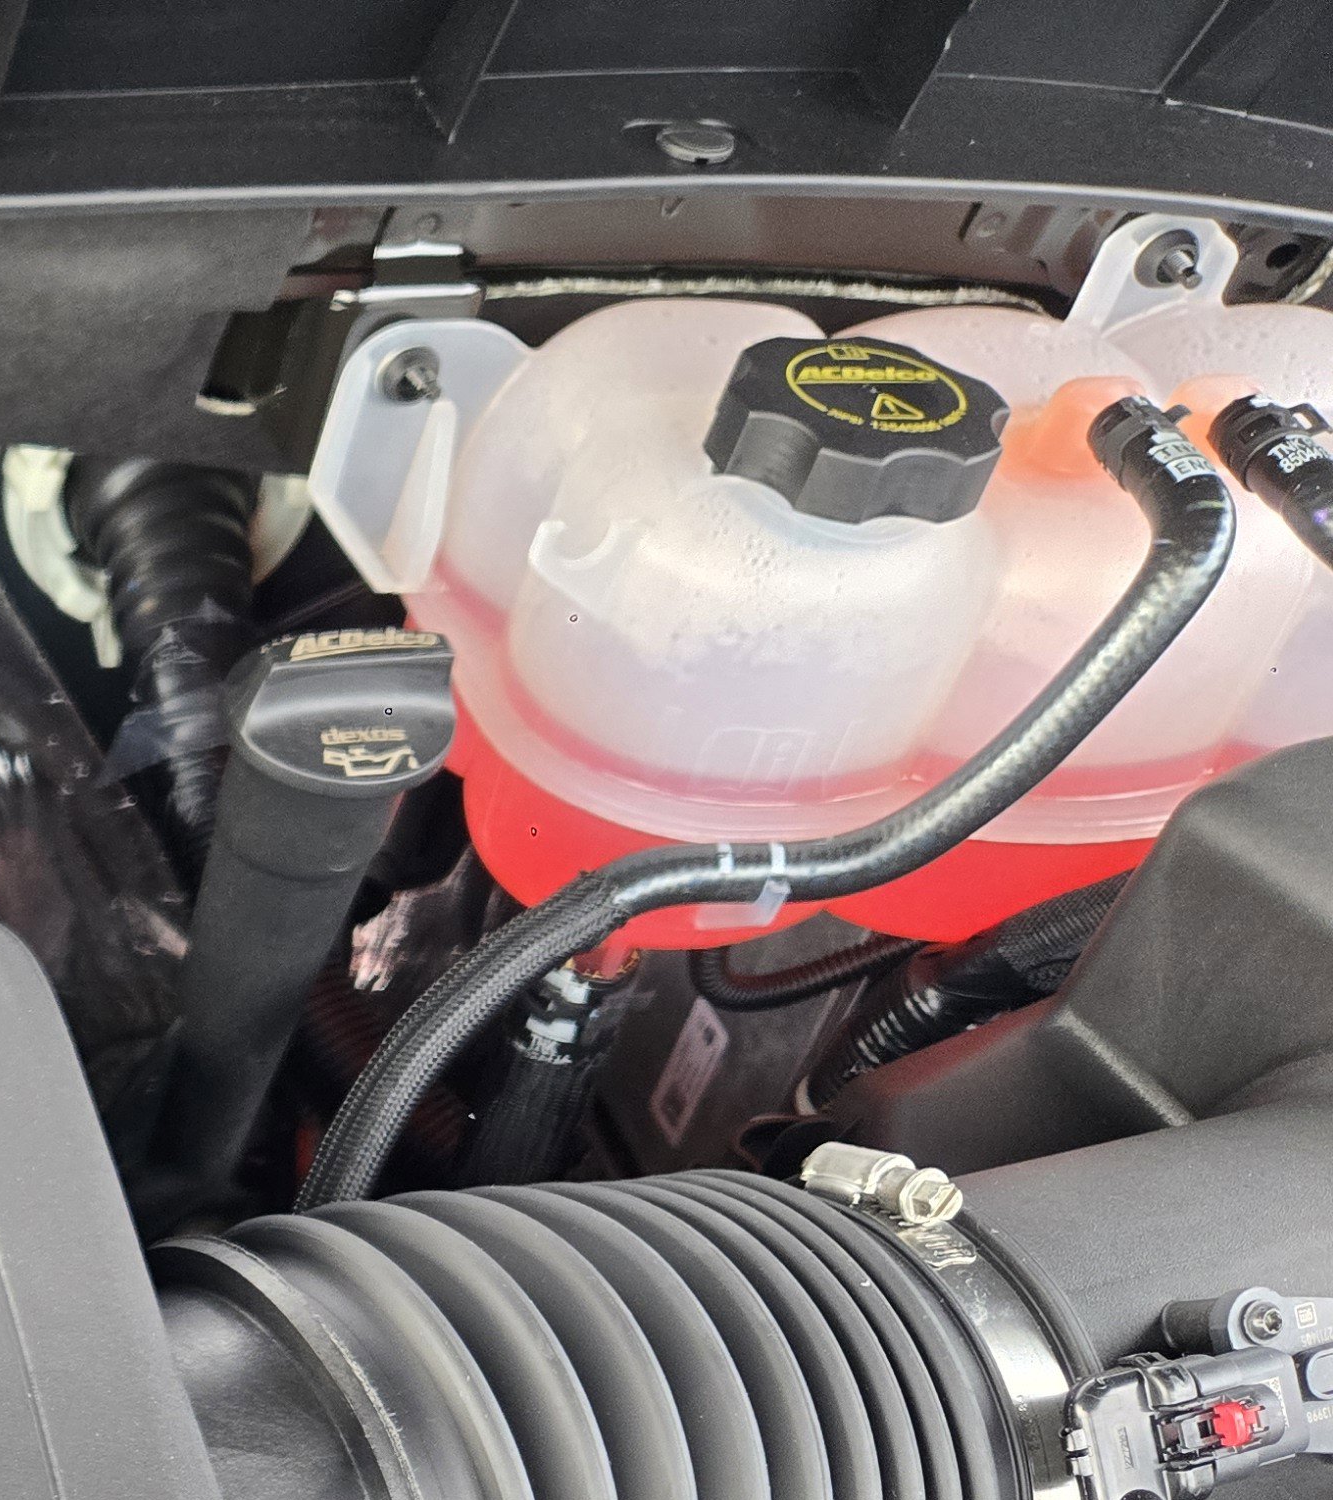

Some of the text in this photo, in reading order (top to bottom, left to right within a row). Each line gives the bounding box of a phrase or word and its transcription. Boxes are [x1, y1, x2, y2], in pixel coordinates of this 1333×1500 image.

[795, 366, 937, 382] ACDelco
[290, 627, 438, 658] ACDelco
[320, 726, 407, 745] dexos
